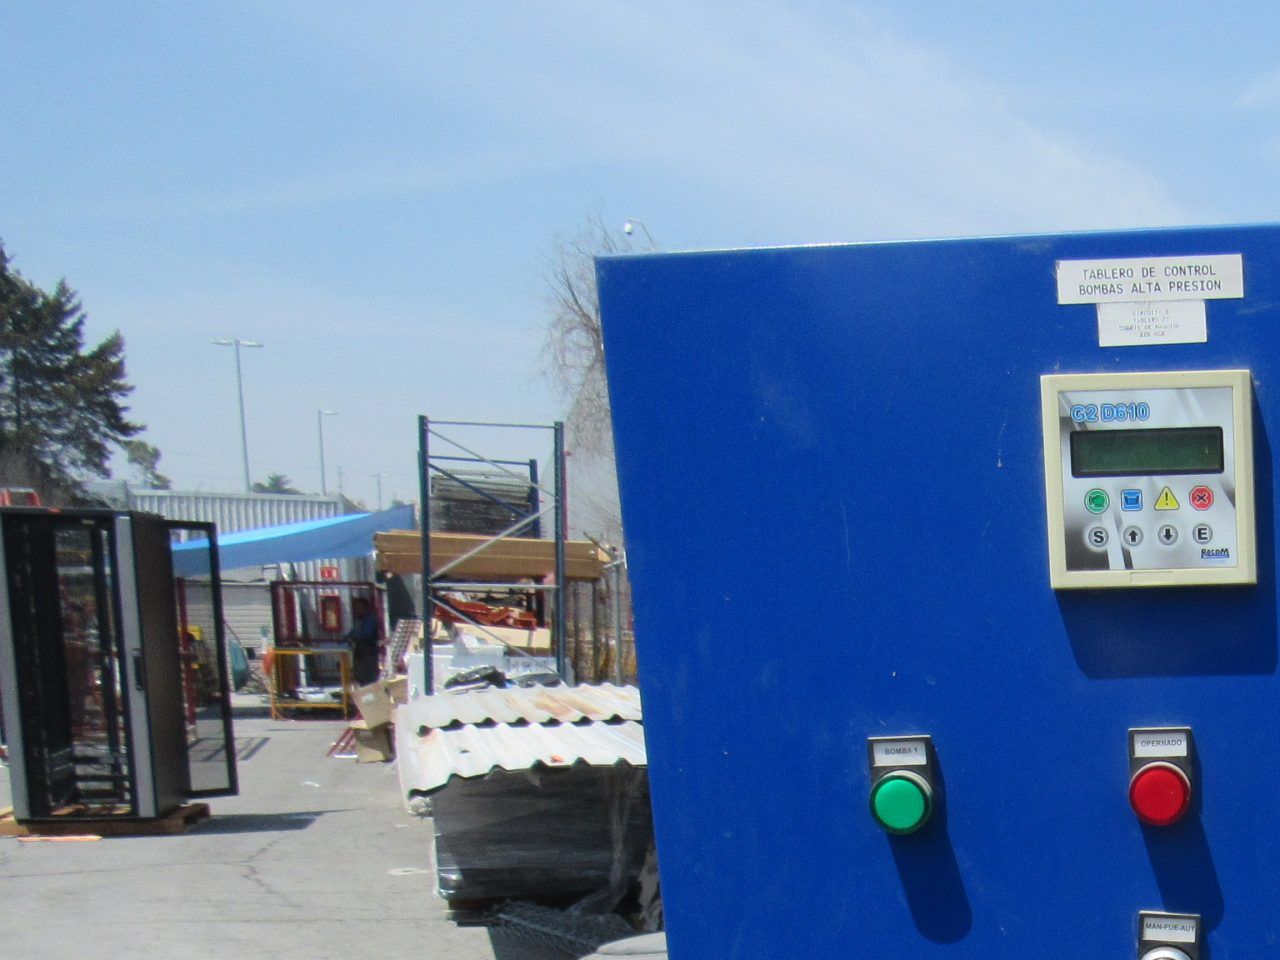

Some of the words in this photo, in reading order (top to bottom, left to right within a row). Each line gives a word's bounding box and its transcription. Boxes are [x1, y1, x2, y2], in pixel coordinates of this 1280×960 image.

[1083, 268, 1134, 280] TABLERO
[1141, 266, 1156, 278] DE
[1164, 264, 1217, 278] CONTROL
[1079, 283, 1124, 296] BOMBAS
[1131, 282, 1162, 294] ALTA
[1169, 280, 1221, 292] PRESION
[1070, 404, 1098, 422] G2
[1101, 402, 1150, 422] D610
[1093, 530, 1104, 544] S
[1197, 527, 1208, 541] E
[1140, 739, 1183, 747] OPERNADO
[884, 747, 912, 755] BOMBA
